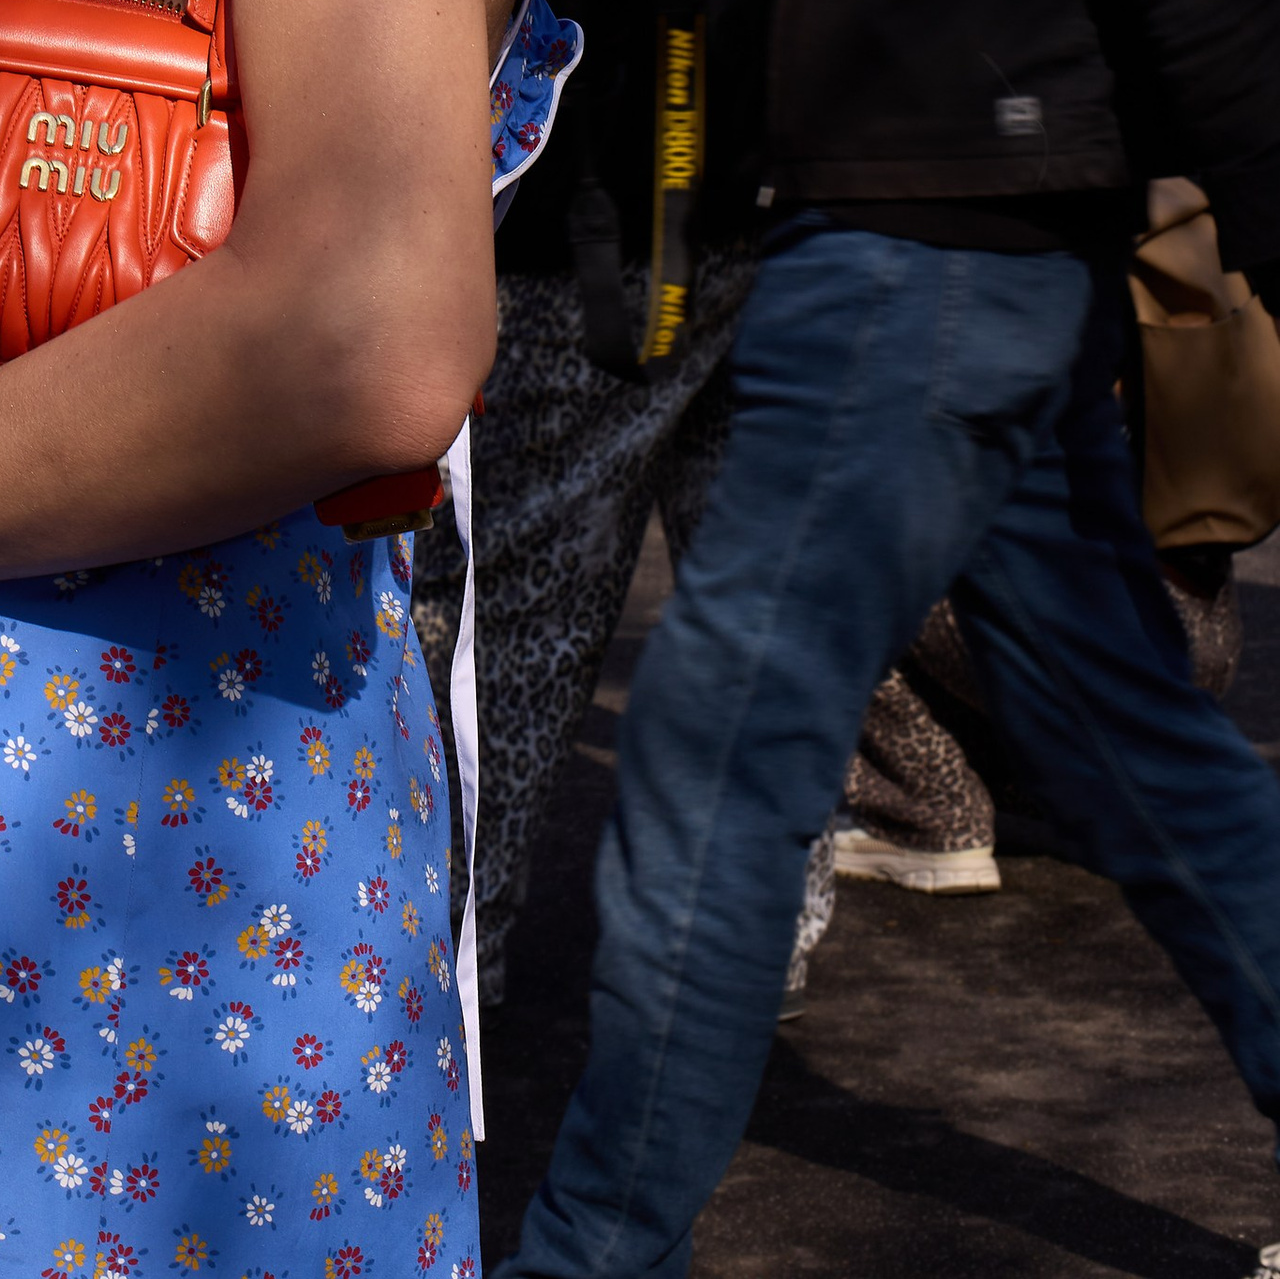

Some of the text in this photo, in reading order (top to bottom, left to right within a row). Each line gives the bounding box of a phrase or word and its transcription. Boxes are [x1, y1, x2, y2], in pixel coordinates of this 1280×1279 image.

[665, 29, 695, 105] Nikon
[26, 112, 129, 156] miu
[19, 157, 121, 202] miu
[650, 283, 688, 357] Nikon
